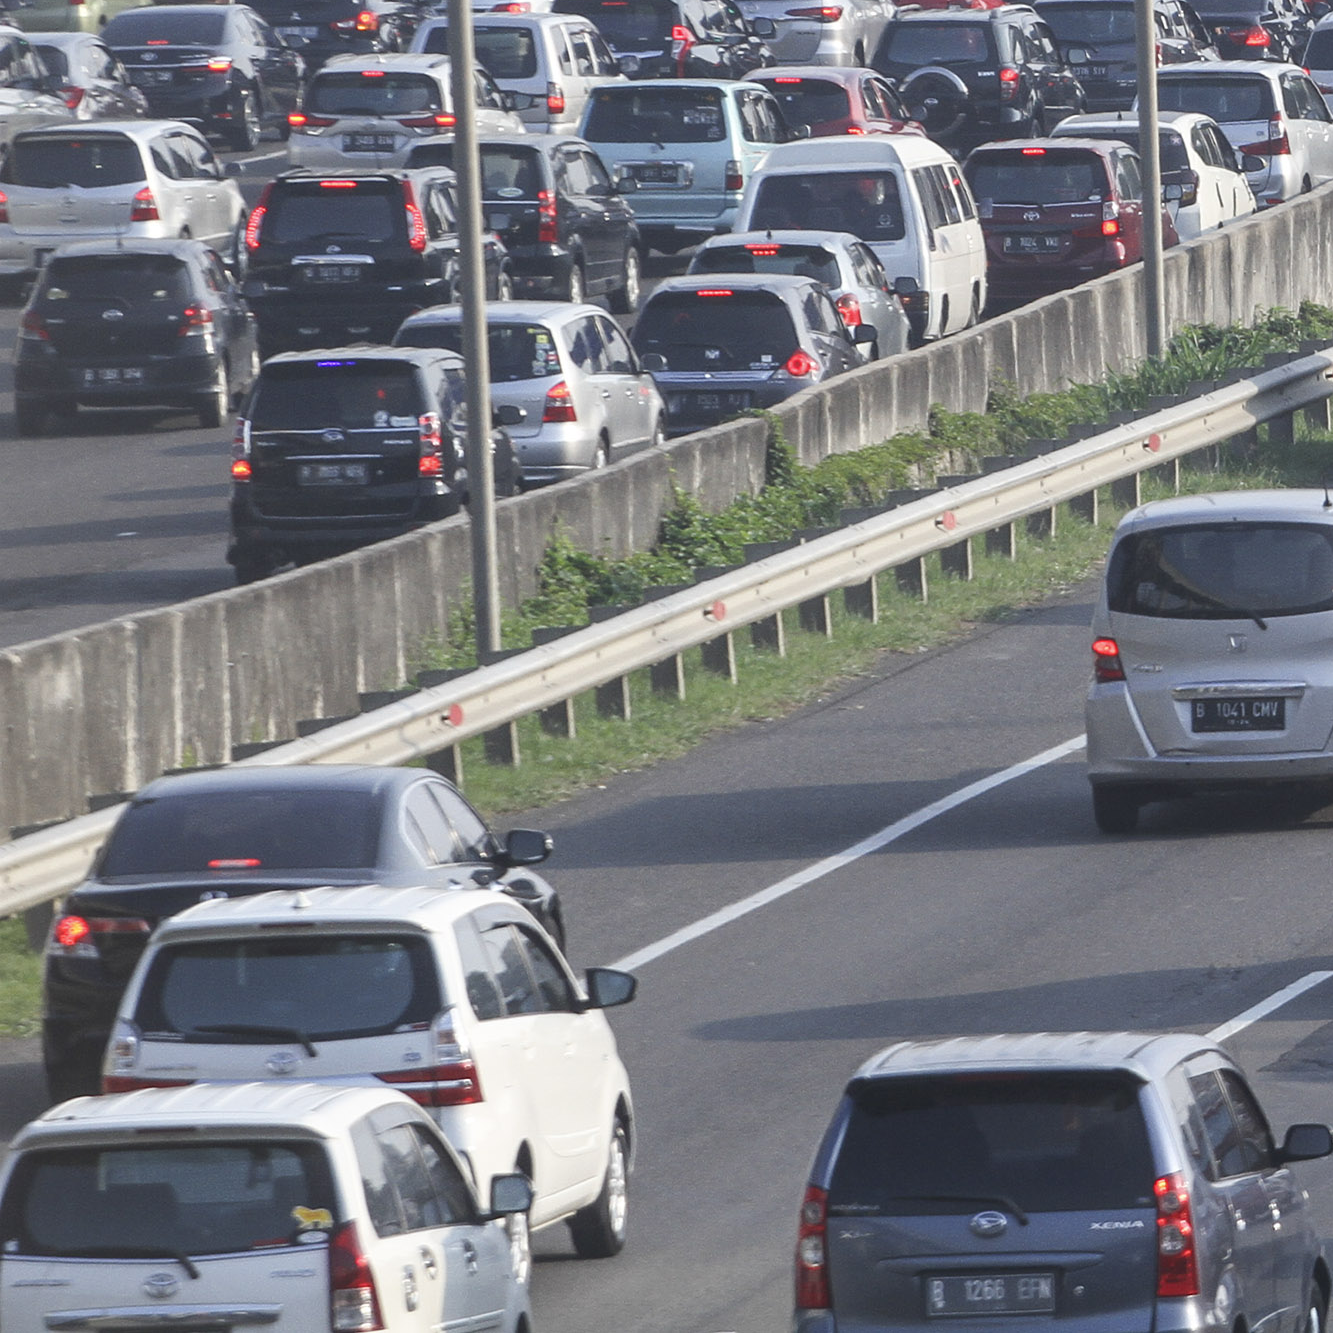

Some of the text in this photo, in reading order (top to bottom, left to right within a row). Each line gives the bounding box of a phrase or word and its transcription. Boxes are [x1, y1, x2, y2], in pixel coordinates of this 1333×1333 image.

[1196, 702, 1278, 717] B 1041 CMV
[1090, 1220, 1144, 1230] XENIA
[933, 1280, 944, 1301] B
[964, 1278, 1005, 1300] 1266
